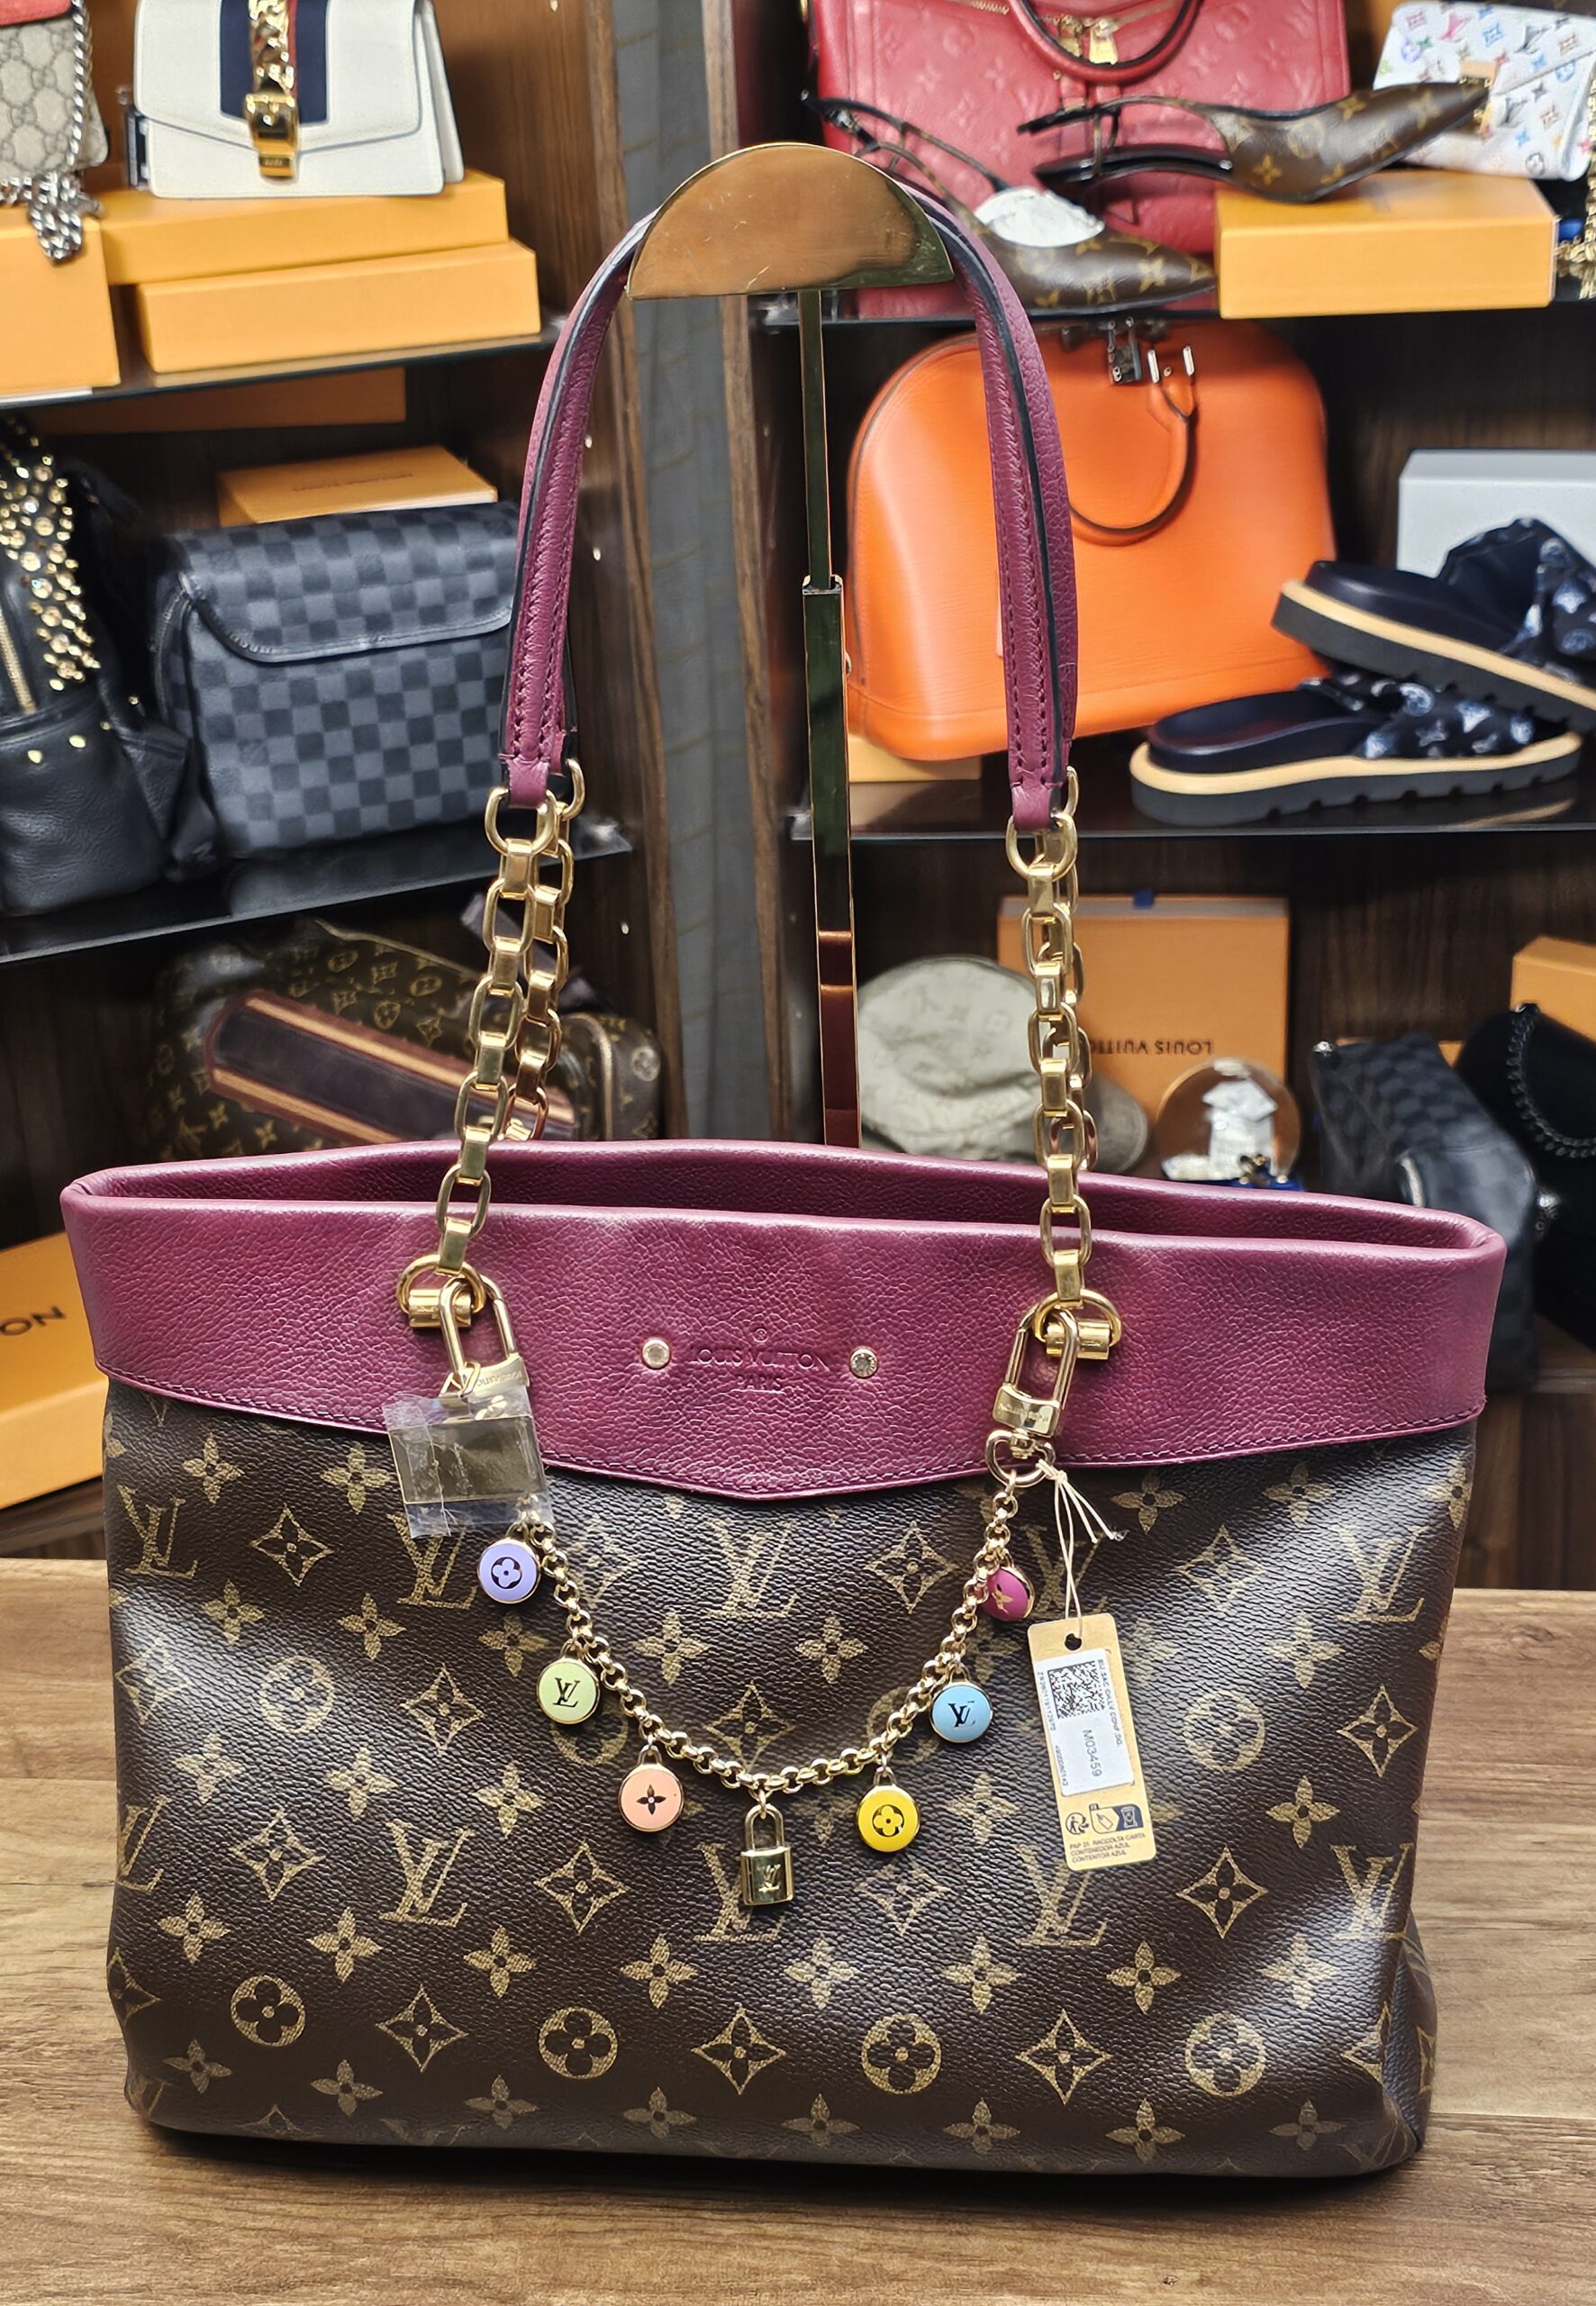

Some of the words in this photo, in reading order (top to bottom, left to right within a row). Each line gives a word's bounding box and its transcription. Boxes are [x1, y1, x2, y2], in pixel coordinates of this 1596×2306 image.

[1088, 1039, 1148, 1055] VUITTO
[1154, 1039, 1212, 1055] LOUIS
[1083, 1730, 1102, 1777] M03459
